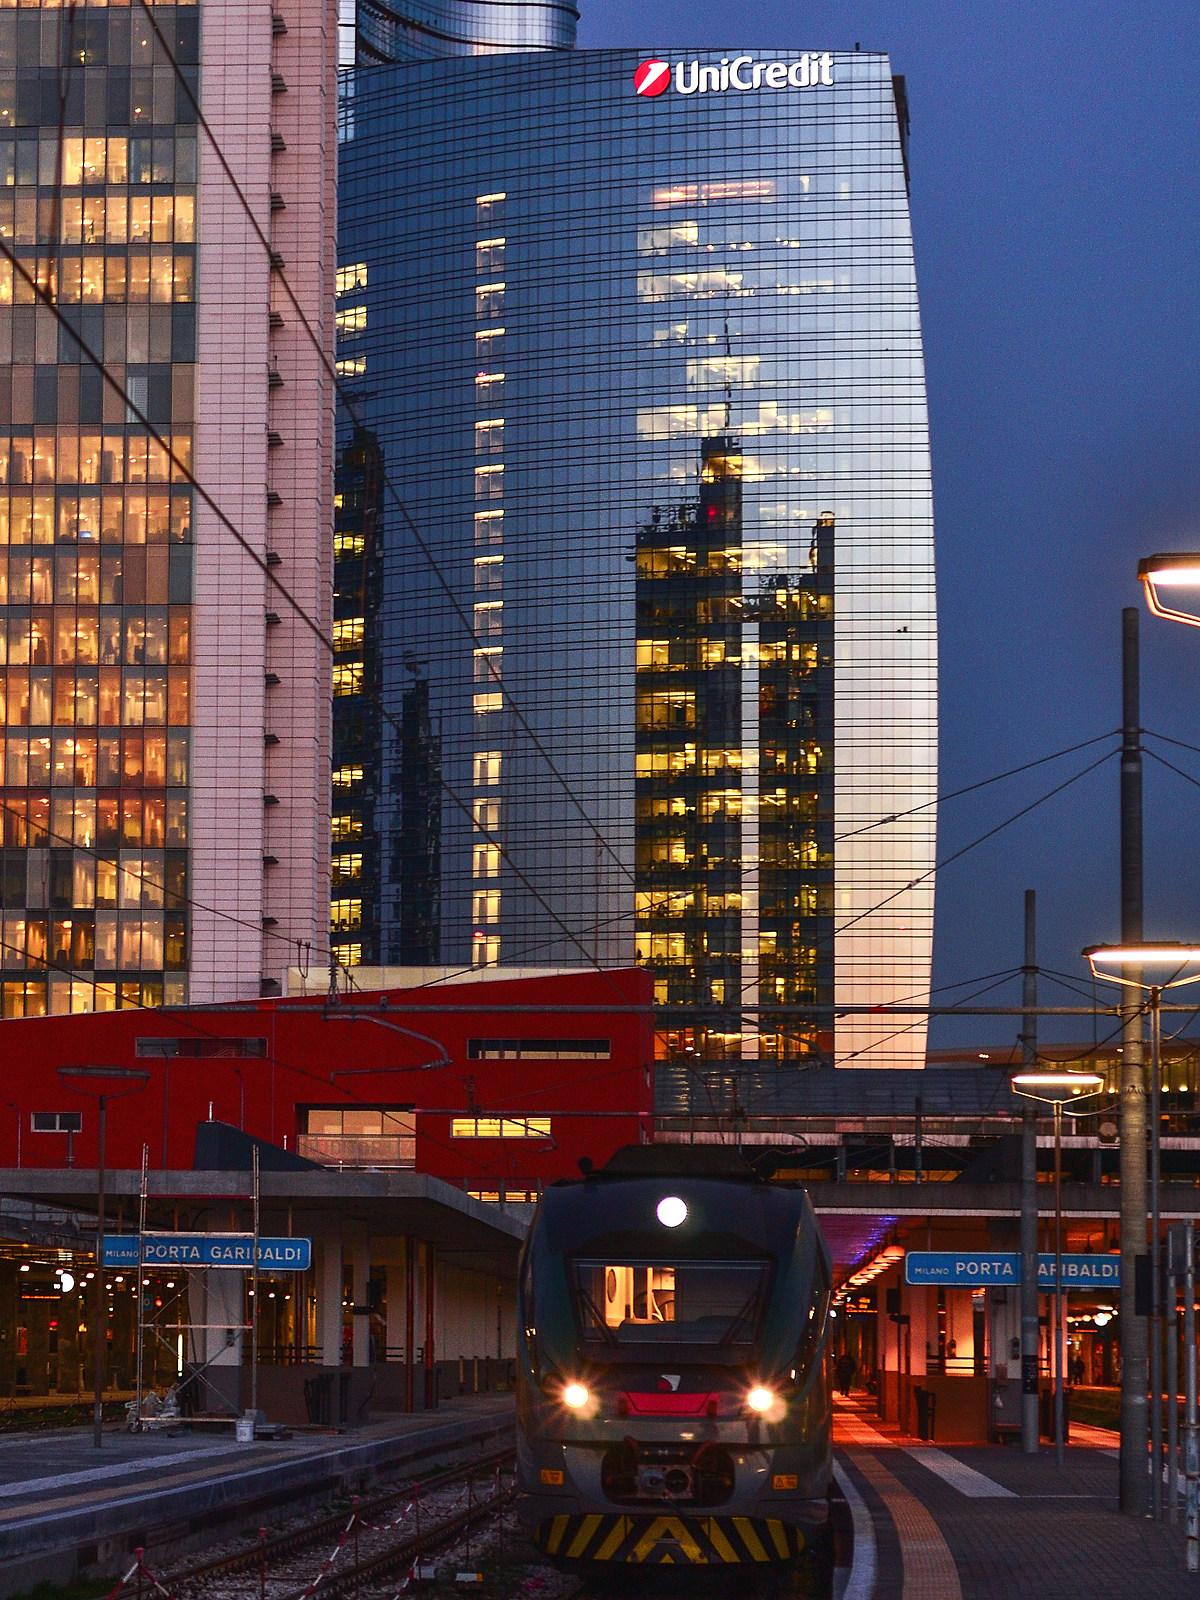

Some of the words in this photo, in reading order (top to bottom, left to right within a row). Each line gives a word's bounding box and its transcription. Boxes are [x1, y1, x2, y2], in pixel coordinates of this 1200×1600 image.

[675, 52, 834, 94] UniCredit
[105, 1250, 139, 1258] MILANO
[145, 1245, 200, 1258] PORTA
[210, 1246, 301, 1260] GARIBALDI
[914, 1267, 949, 1275] MILANO
[955, 1262, 1013, 1275] PORTA
[1037, 1263, 1119, 1277] ARIBALDI
